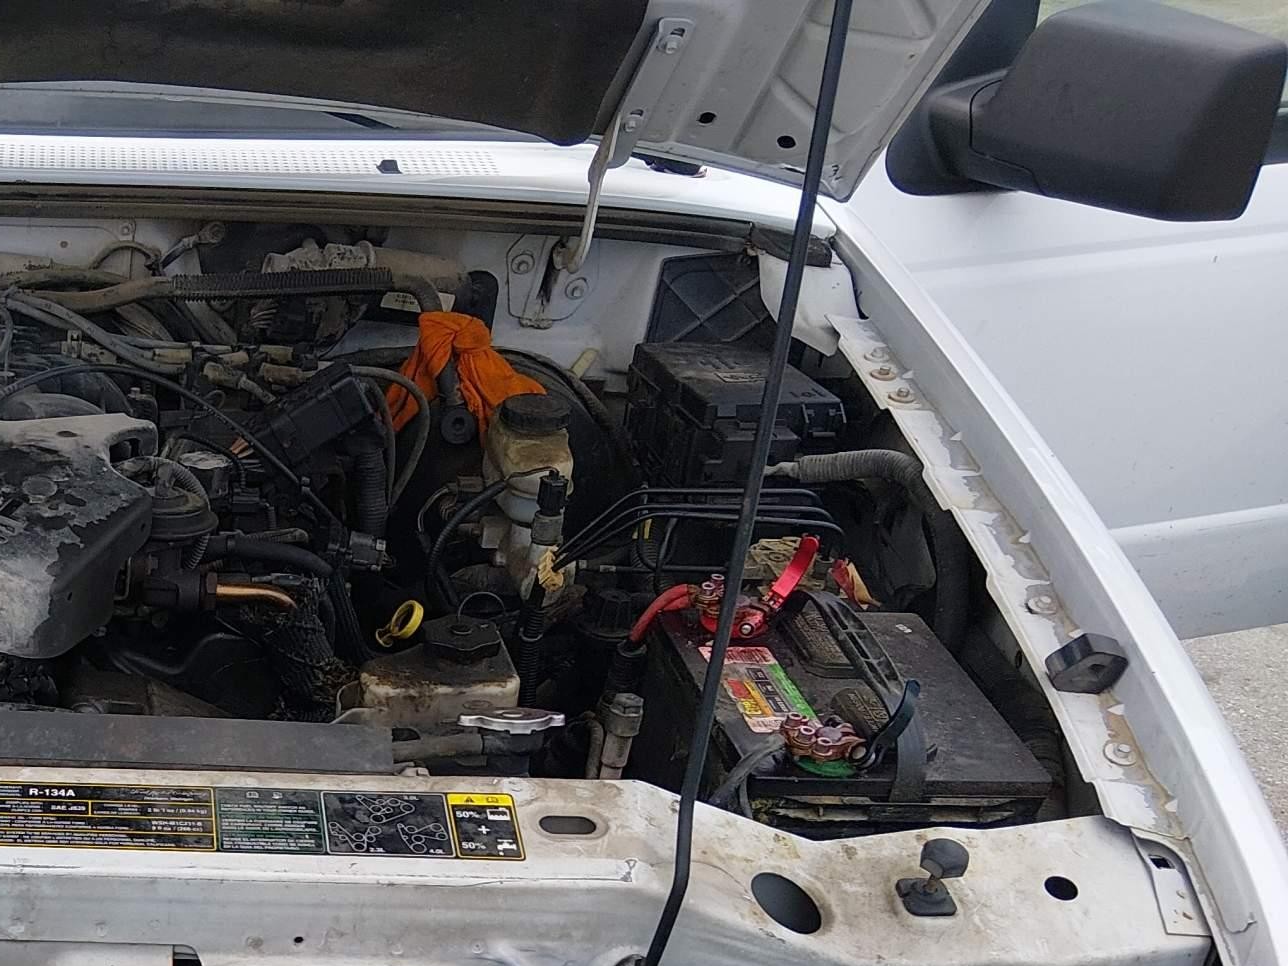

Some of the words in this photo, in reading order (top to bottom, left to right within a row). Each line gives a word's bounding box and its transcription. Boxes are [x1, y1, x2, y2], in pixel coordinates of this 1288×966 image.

[29, 788, 76, 797] R-134A
[456, 810, 480, 818] 50%
[462, 842, 486, 850] 50%
